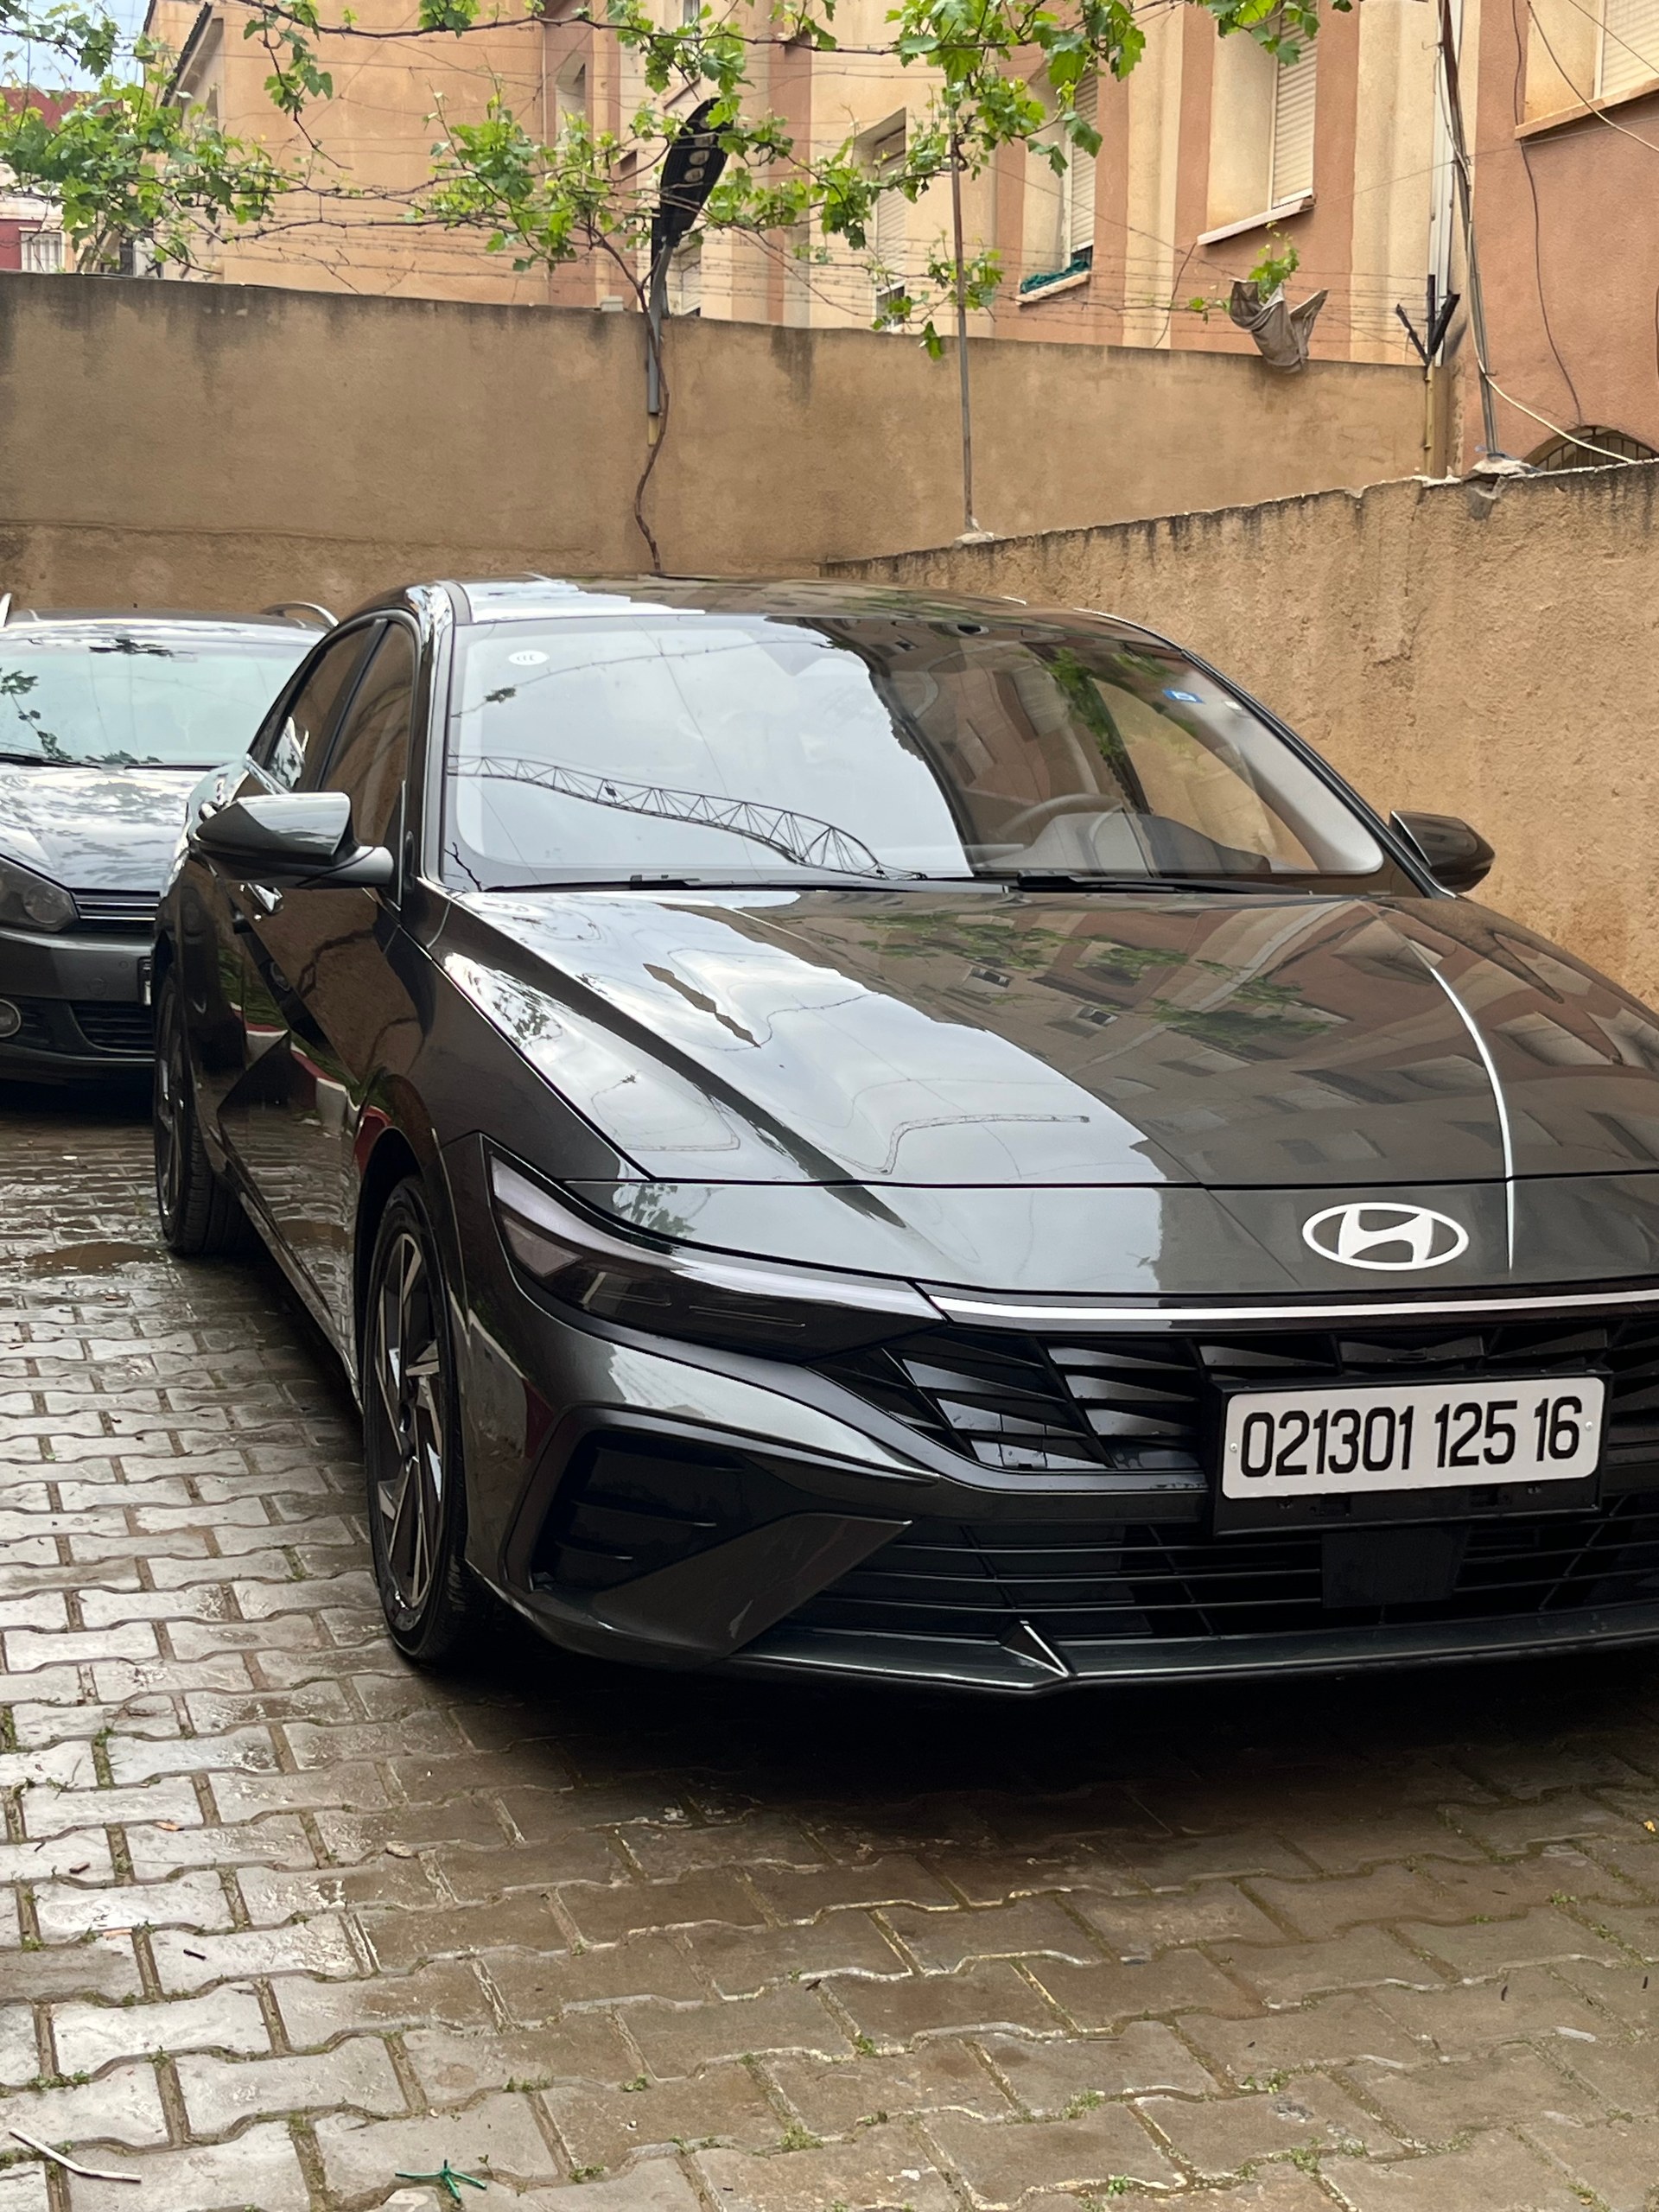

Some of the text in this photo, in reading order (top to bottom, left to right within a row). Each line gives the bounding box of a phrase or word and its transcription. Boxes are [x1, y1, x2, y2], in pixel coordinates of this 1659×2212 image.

[1240, 1395, 1583, 1478] 021301 125 16
